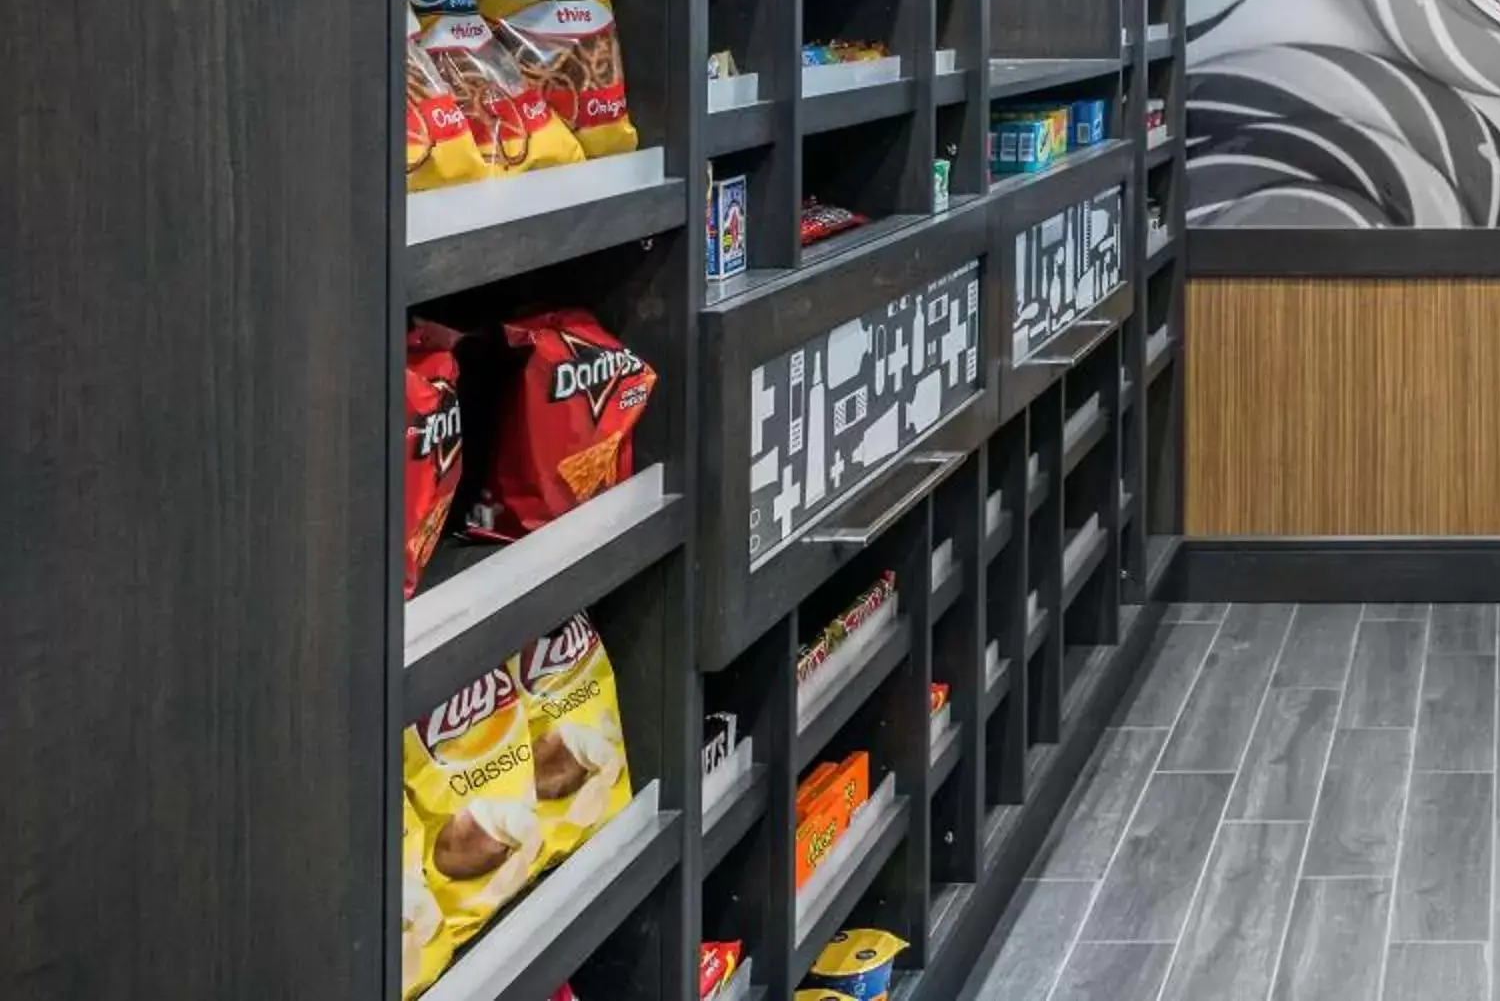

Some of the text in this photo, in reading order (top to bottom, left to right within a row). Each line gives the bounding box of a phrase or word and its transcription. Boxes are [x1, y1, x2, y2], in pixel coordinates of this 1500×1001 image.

[556, 7, 593, 23] thins
[555, 348, 644, 399] Doritos
[541, 680, 600, 719] Classic
[449, 743, 531, 798] Classic
